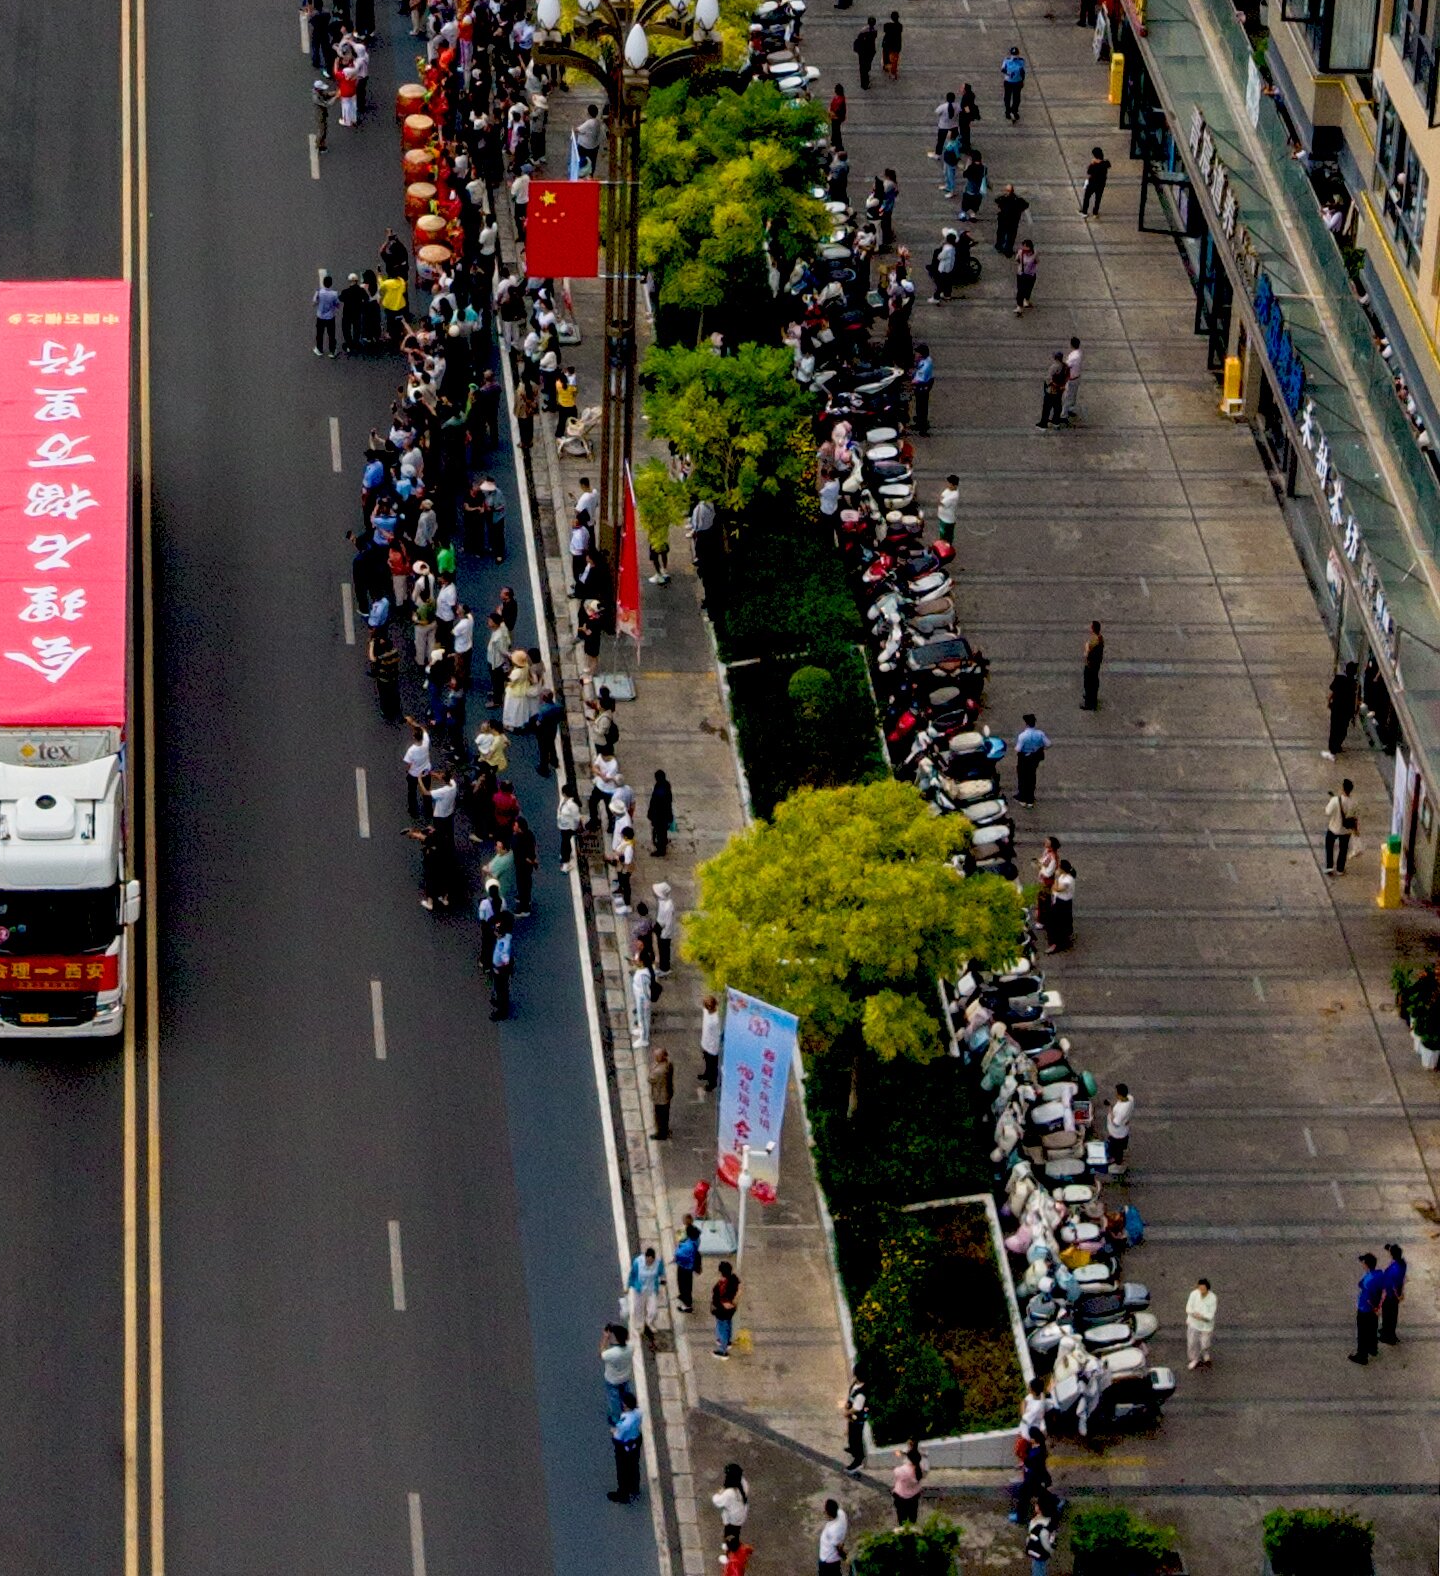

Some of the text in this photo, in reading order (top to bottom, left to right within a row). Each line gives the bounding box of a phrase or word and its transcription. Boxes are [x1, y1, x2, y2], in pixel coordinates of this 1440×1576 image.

[3, 339, 101, 684] 会理石榴万里行
[38, 740, 73, 762] tex
[64, 962, 106, 980] 西安
